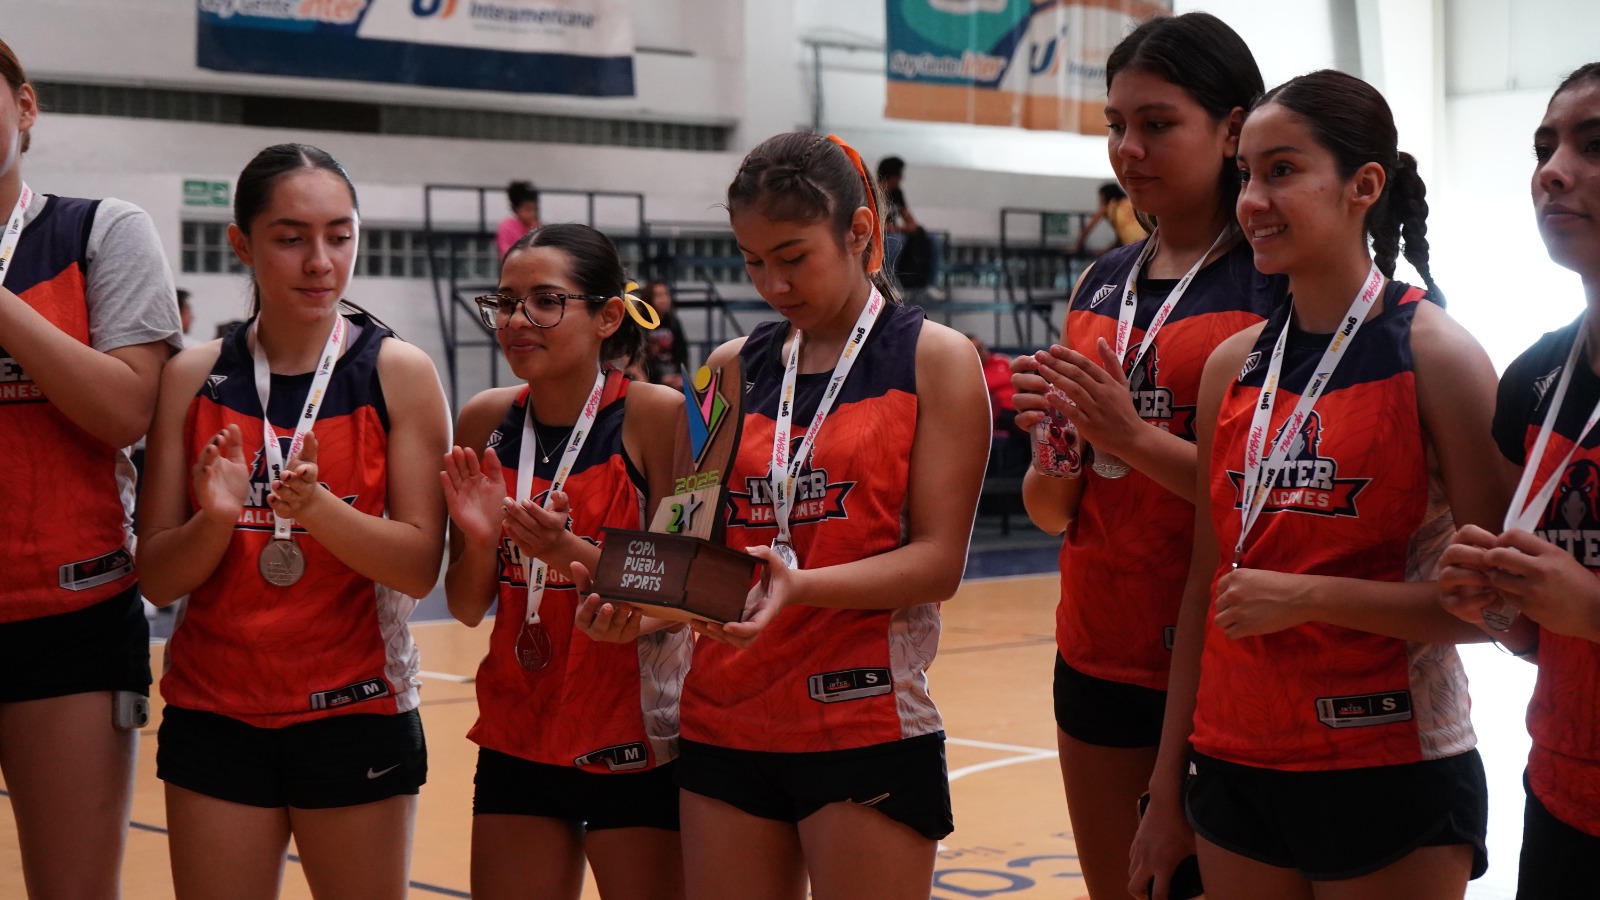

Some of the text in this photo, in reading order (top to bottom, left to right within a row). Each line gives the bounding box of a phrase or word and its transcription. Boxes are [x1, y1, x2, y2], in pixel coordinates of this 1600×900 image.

[471, 2, 595, 28] Interamericana
[585, 385, 604, 420] MEXBALL
[805, 411, 825, 447] MEXBALL
[1280, 411, 1303, 453] MEXBALL
[776, 431, 788, 468] MEXBALL
[1247, 426, 1264, 469] MEXBALL
[675, 470, 720, 495] 2025
[667, 503, 682, 533] 2
[628, 541, 656, 557] COPA
[624, 556, 666, 575] PUEBLA
[620, 573, 662, 592] SPORTS
[362, 682, 379, 695] M
[865, 673, 878, 684] S
[1382, 698, 1396, 711] S
[624, 747, 639, 761] M
